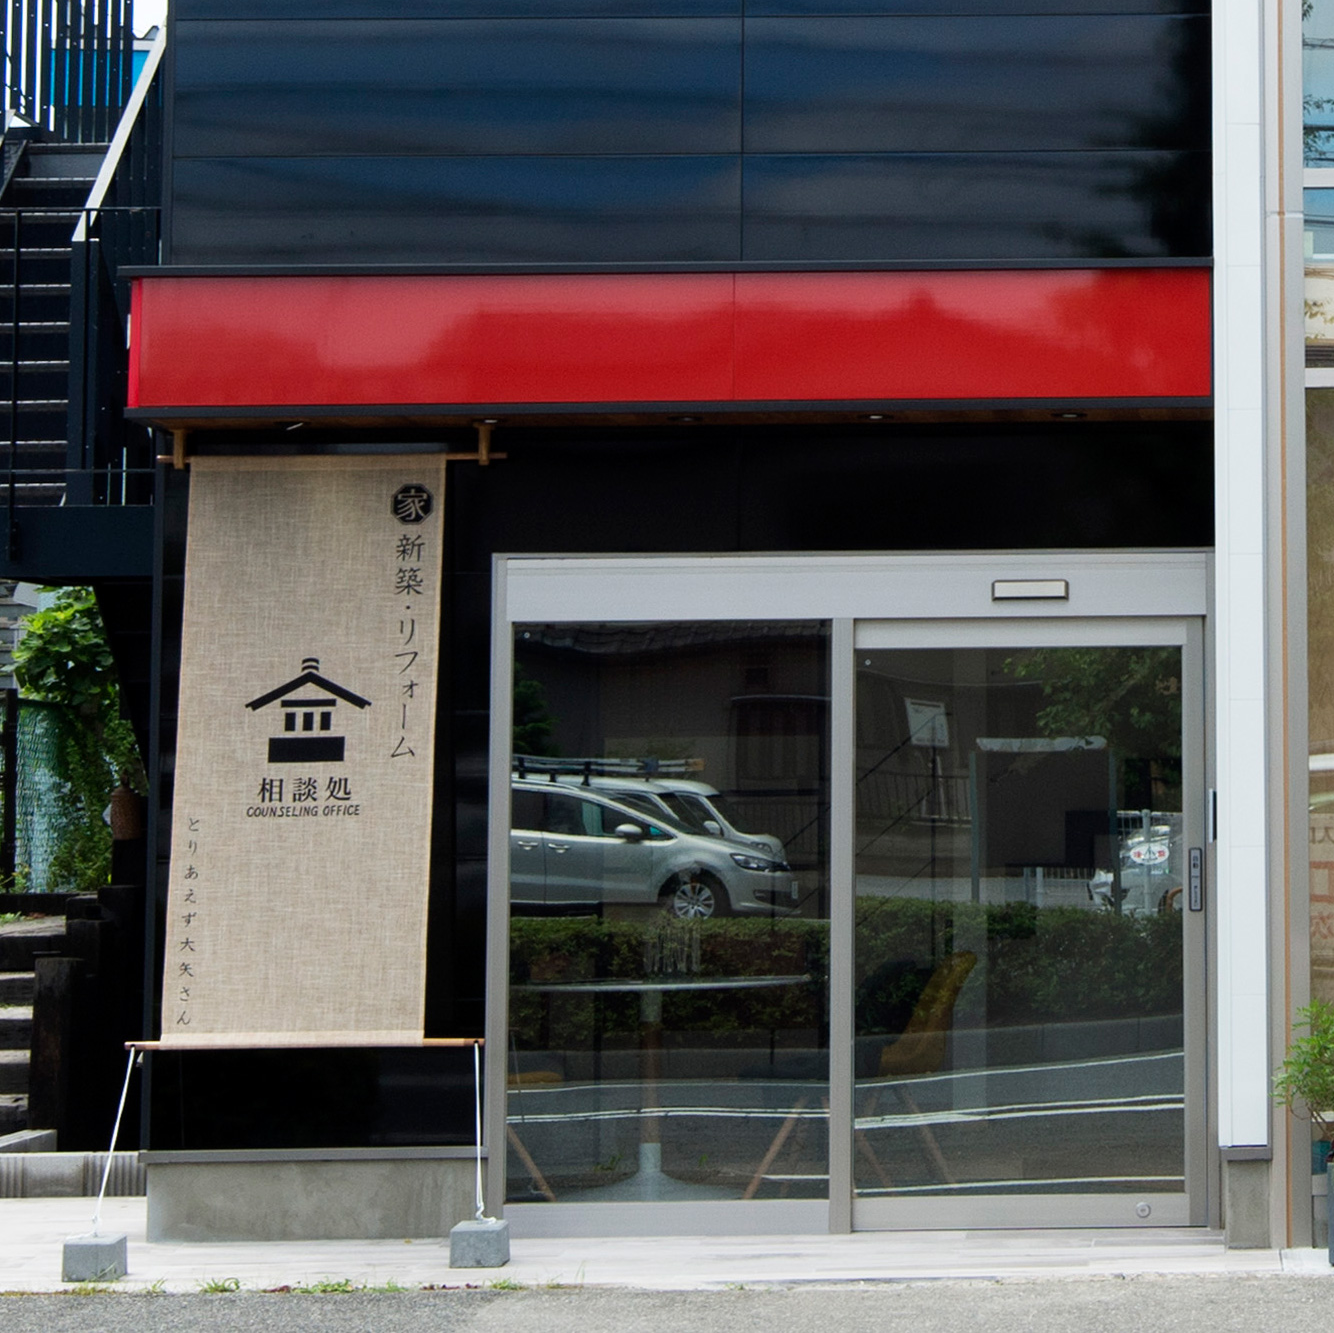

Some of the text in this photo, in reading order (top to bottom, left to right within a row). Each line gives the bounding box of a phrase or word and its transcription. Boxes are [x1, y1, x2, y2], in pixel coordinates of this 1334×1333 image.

[398, 488, 427, 521] 家
[391, 533, 426, 759] 新築・リフォーム
[257, 776, 353, 803] 相談処
[246, 804, 361, 818] COUNSELING OFFICE
[176, 817, 200, 1026] とりあえず大矢さん
